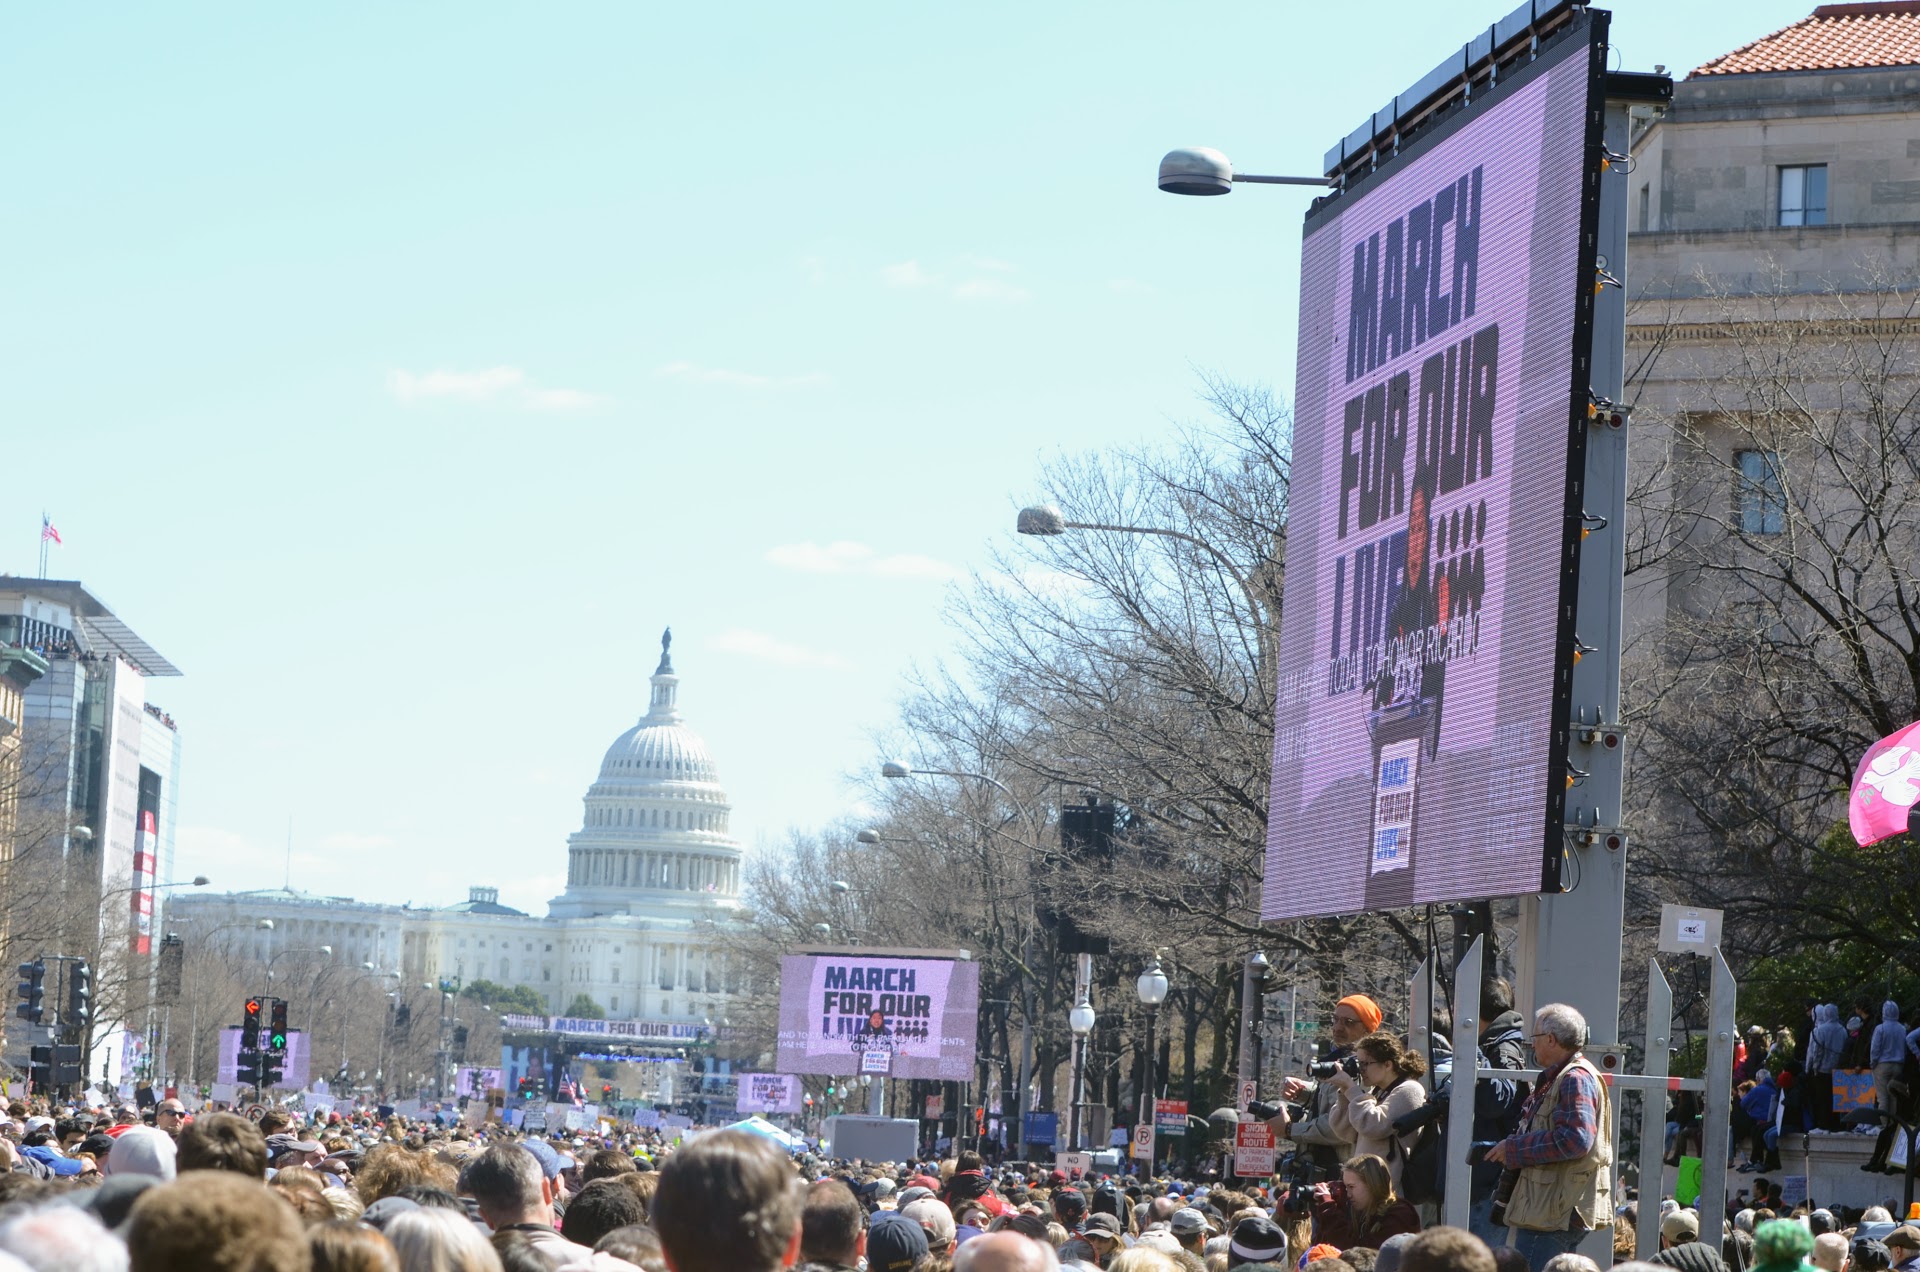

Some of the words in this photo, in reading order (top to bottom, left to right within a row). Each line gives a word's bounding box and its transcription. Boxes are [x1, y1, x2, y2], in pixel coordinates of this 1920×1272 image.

[1346, 164, 1483, 385] MARCH
[1338, 369, 1410, 540] FOR
[1412, 322, 1499, 502] OUR
[1328, 516, 1434, 692] LIV
[1366, 642, 1379, 684] TO
[1382, 628, 1424, 680] HONOR
[1426, 610, 1482, 665] RICARDO
[1380, 755, 1409, 789] MARCH
[824, 966, 916, 992] MARCH
[823, 991, 873, 1017] FOR
[879, 993, 931, 1018] OUR
[555, 1018, 605, 1032] MARCH
[609, 1022, 636, 1035] FOR
[640, 1024, 669, 1037] OUR
[822, 1016, 894, 1039] LIV
[1245, 1124, 1268, 1133] SNOW
[1243, 1138, 1268, 1147] ROUTE
[1067, 1156, 1079, 1164] NO
